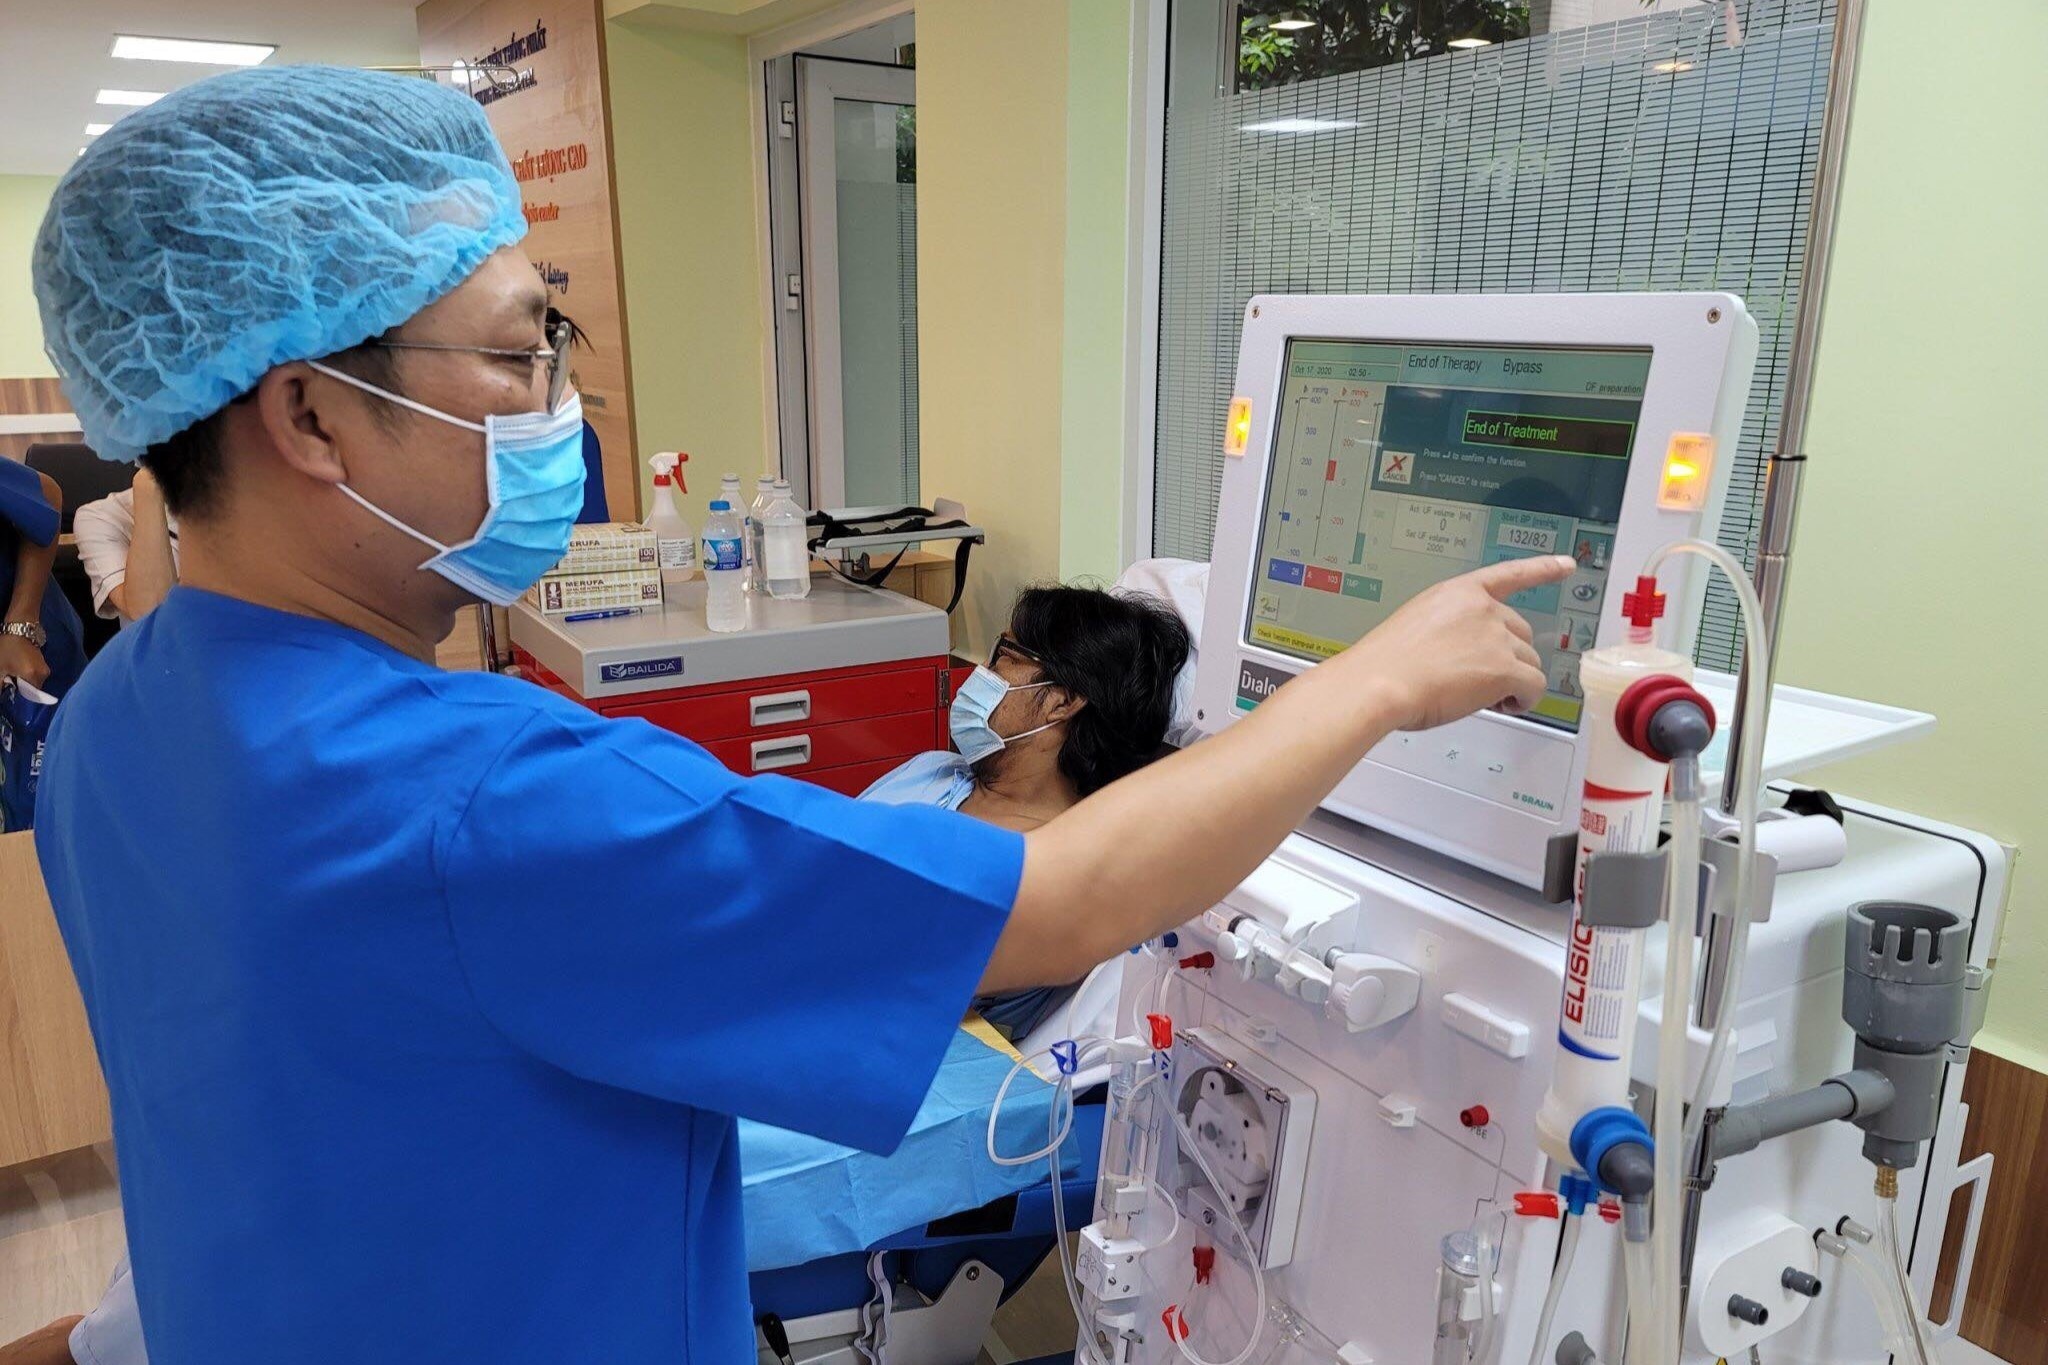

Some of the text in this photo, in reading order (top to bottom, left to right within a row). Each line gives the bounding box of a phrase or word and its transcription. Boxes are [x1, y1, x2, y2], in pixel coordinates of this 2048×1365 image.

[567, 143, 587, 171] CAO
[1408, 354, 1543, 375] End of Therapy Bypass
[1600, 382, 1642, 394] preparation
[1305, 427, 1317, 435] 300
[1466, 419, 1559, 441] End of Treatment
[1423, 448, 1527, 468] Press to confirm the function
[1382, 472, 1408, 482] CANCEL
[1419, 471, 1437, 481] Press
[1471, 478, 1478, 487] to
[1479, 479, 1500, 490] return
[1440, 518, 1447, 531] 0
[1509, 528, 1548, 548] 132/82
[569, 539, 601, 548] ERUFA
[640, 548, 655, 556] 100
[565, 579, 605, 588] MERUFA
[643, 584, 657, 593] 100
[627, 662, 676, 675] BAILIDA
[1241, 669, 1277, 696] Dialo
[1521, 793, 1554, 811] BRAUN
